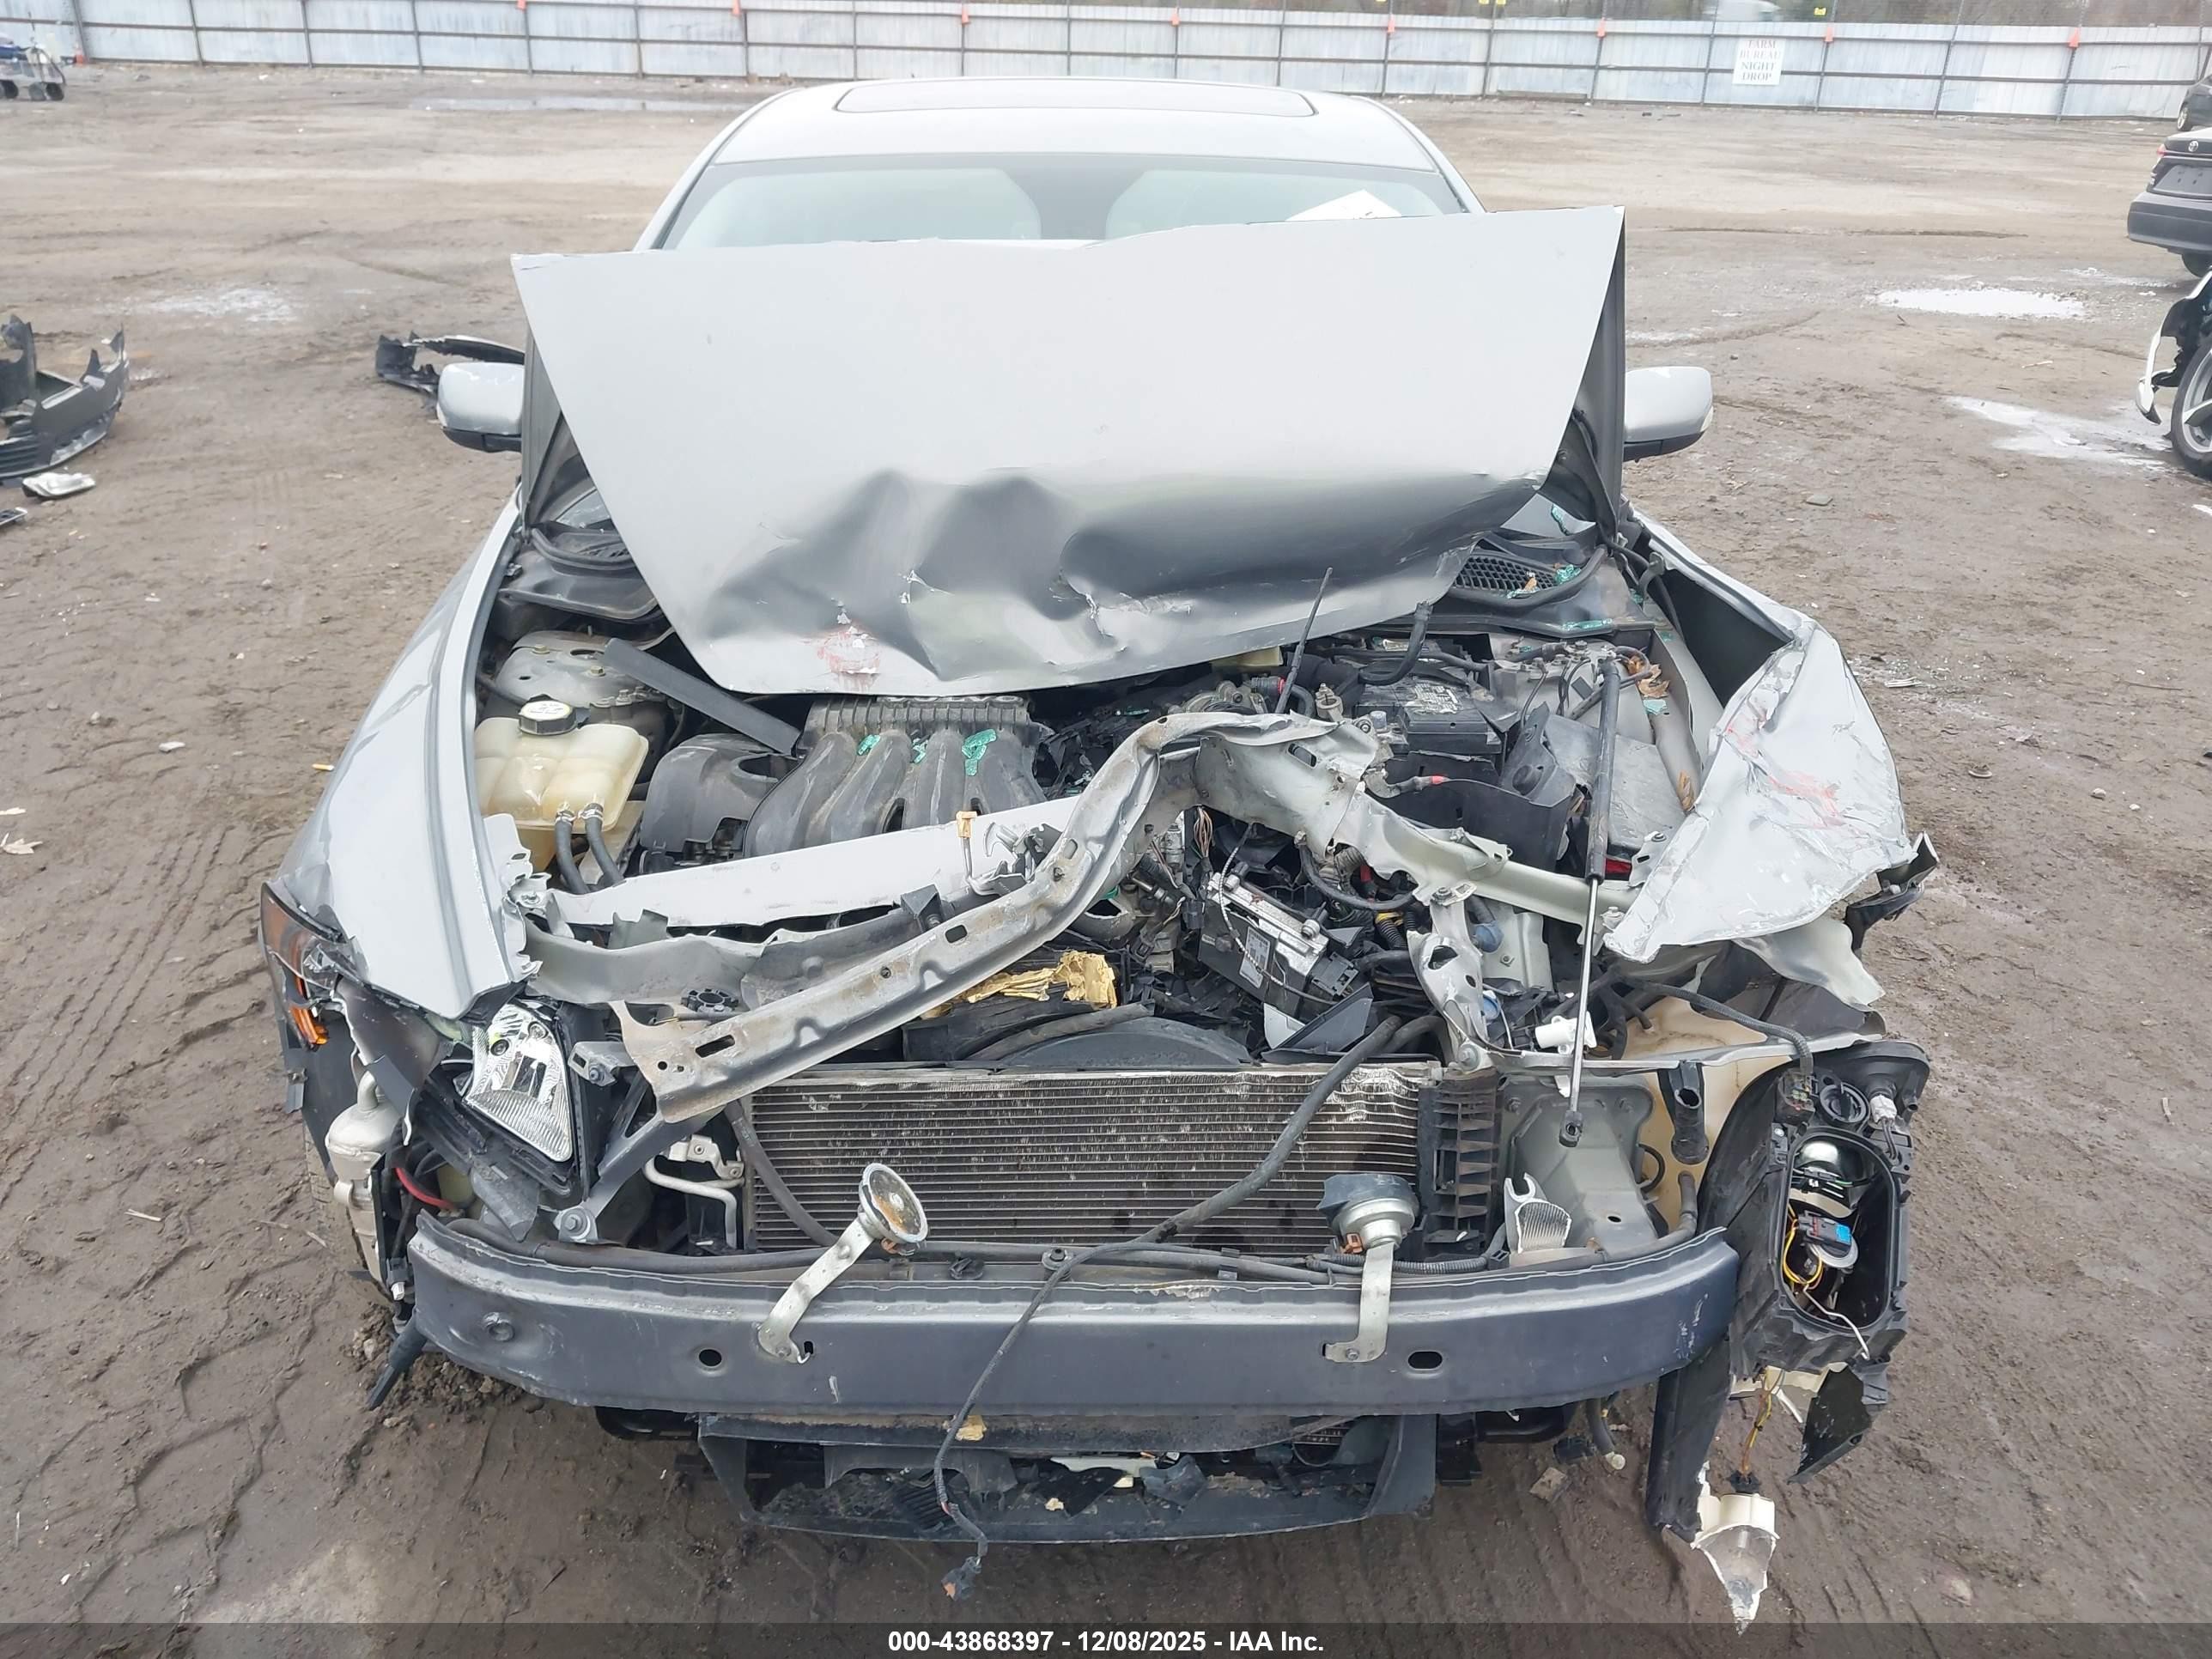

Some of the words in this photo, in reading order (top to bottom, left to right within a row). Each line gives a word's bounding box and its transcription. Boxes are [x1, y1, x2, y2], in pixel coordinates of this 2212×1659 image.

[1747, 40, 1777, 48] FARM
[1741, 62, 1775, 70] NIGHT
[1741, 72, 1771, 81] DROP
